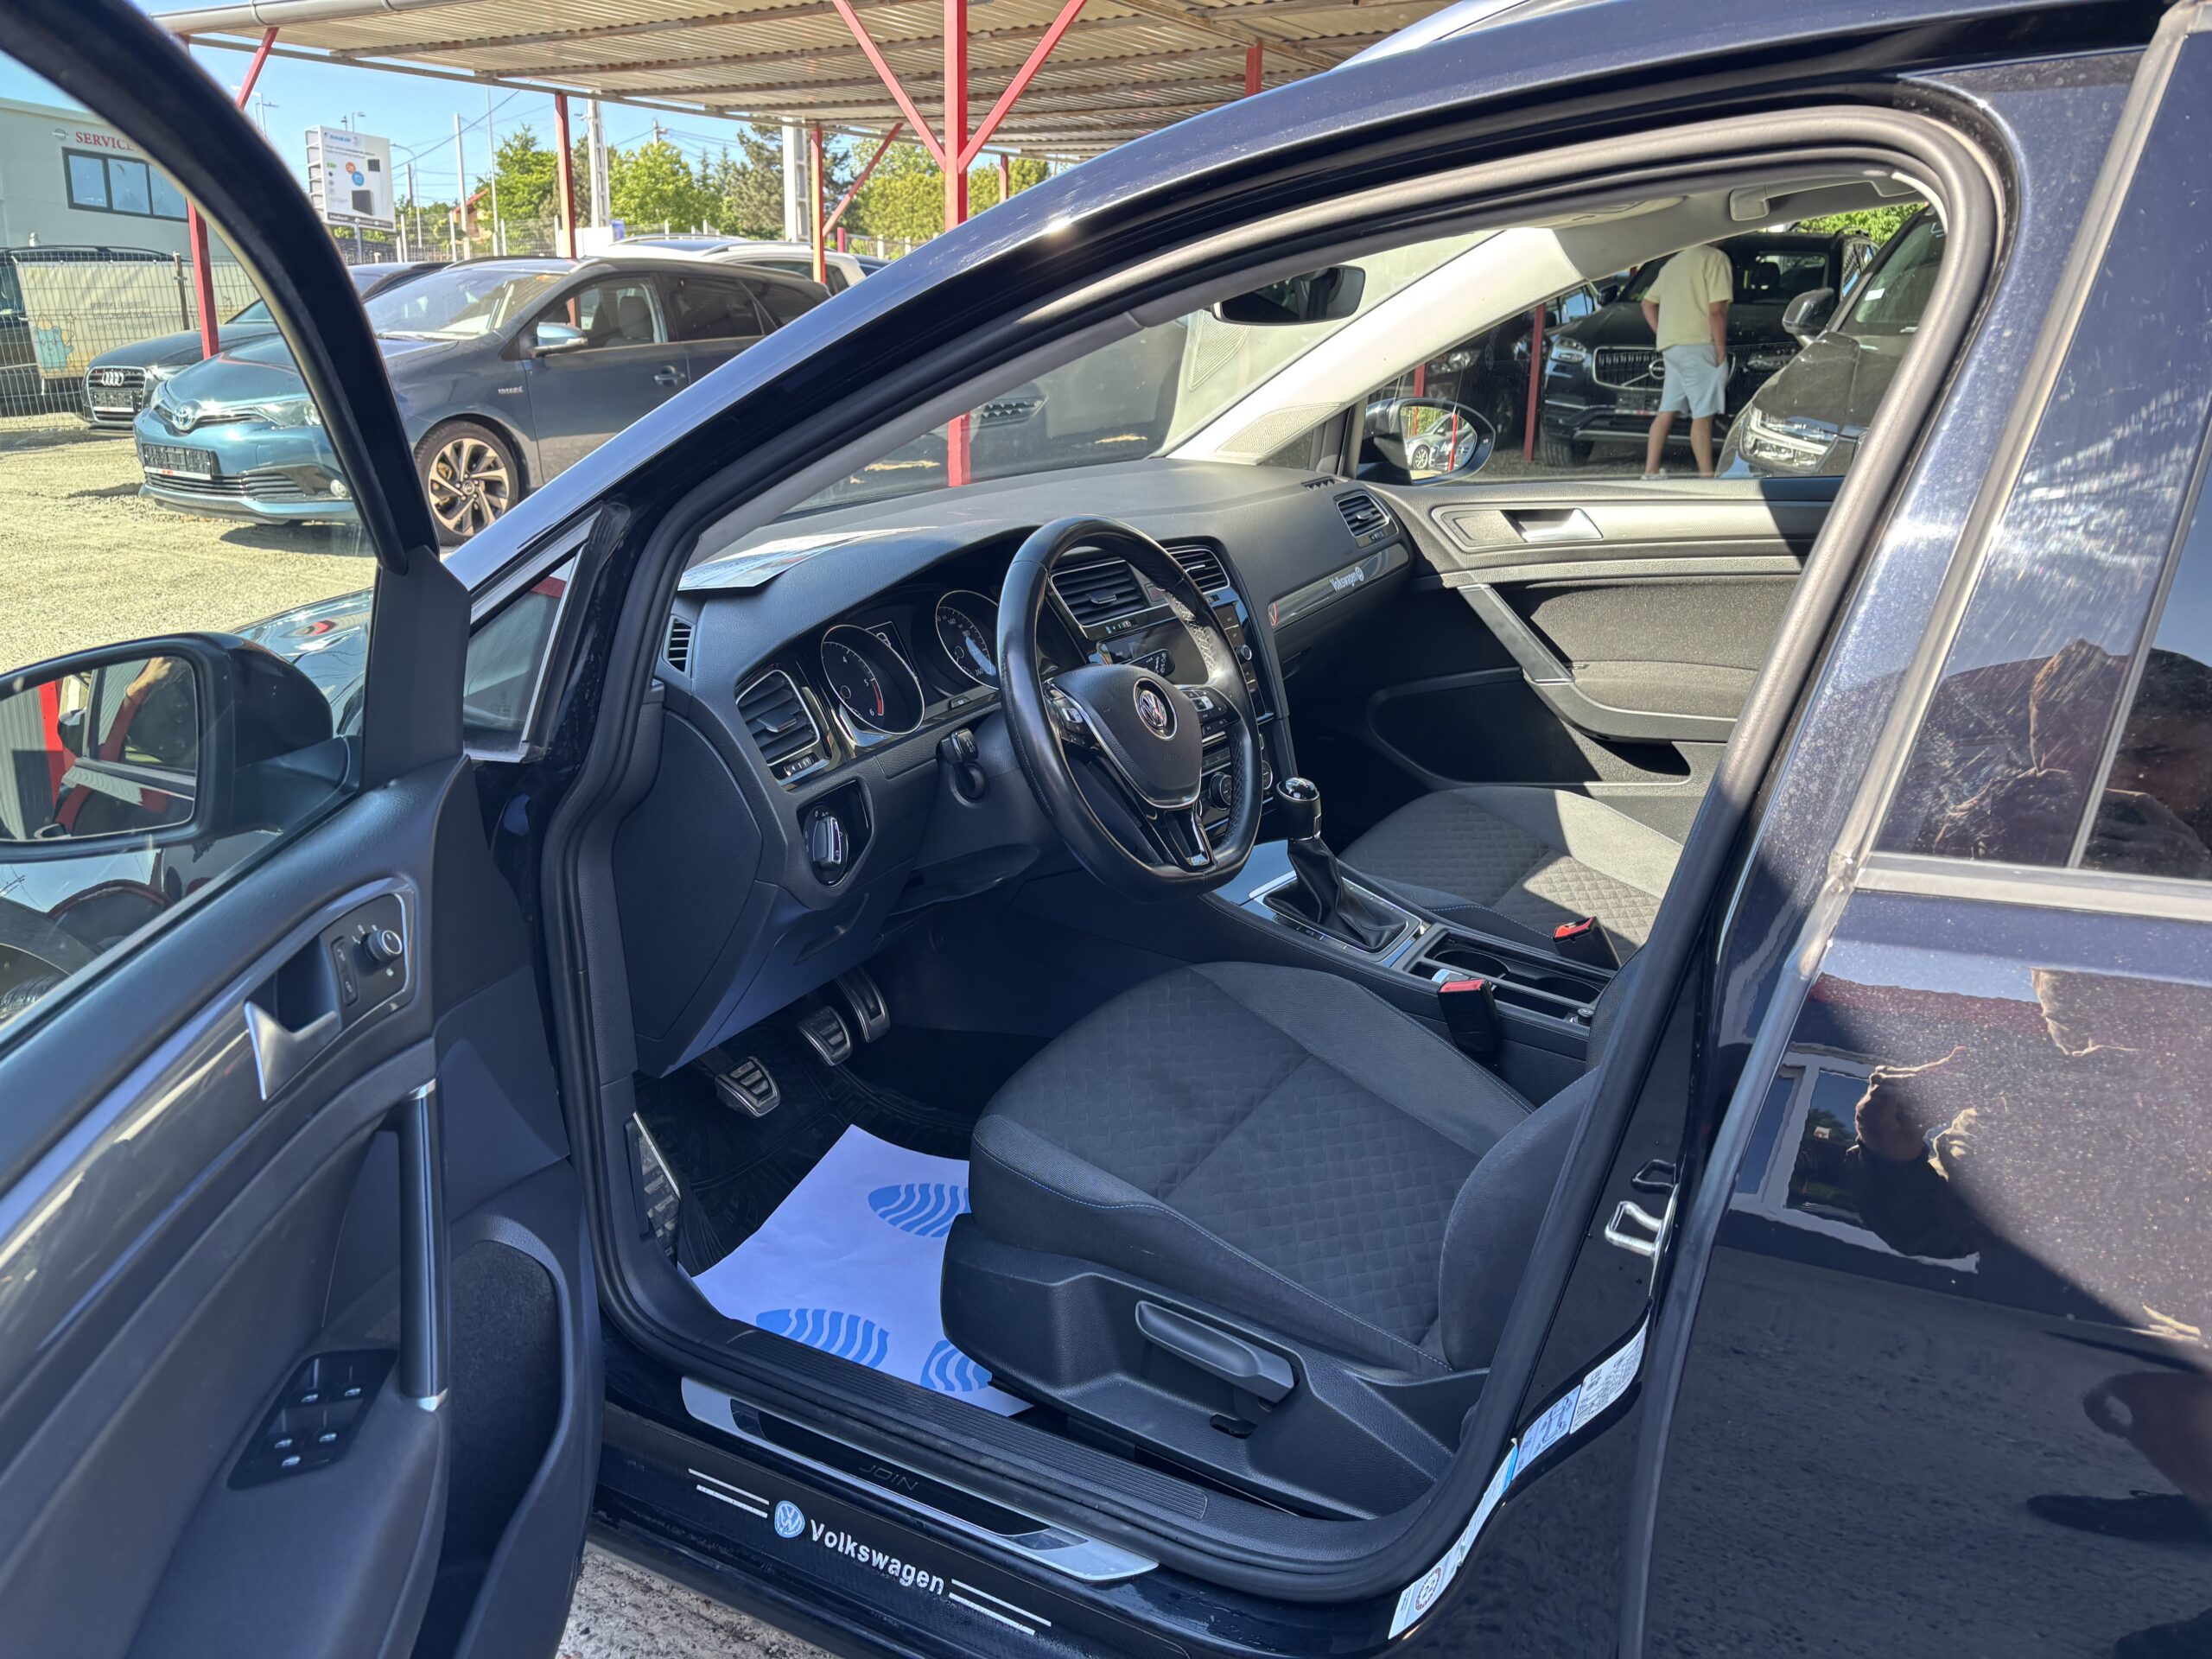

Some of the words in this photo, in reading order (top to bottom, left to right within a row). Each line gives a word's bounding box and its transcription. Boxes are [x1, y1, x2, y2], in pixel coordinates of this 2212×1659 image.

[863, 678, 869, 687] 5
[869, 708, 875, 716] 6
[810, 1519, 945, 1596] Volkswagen
